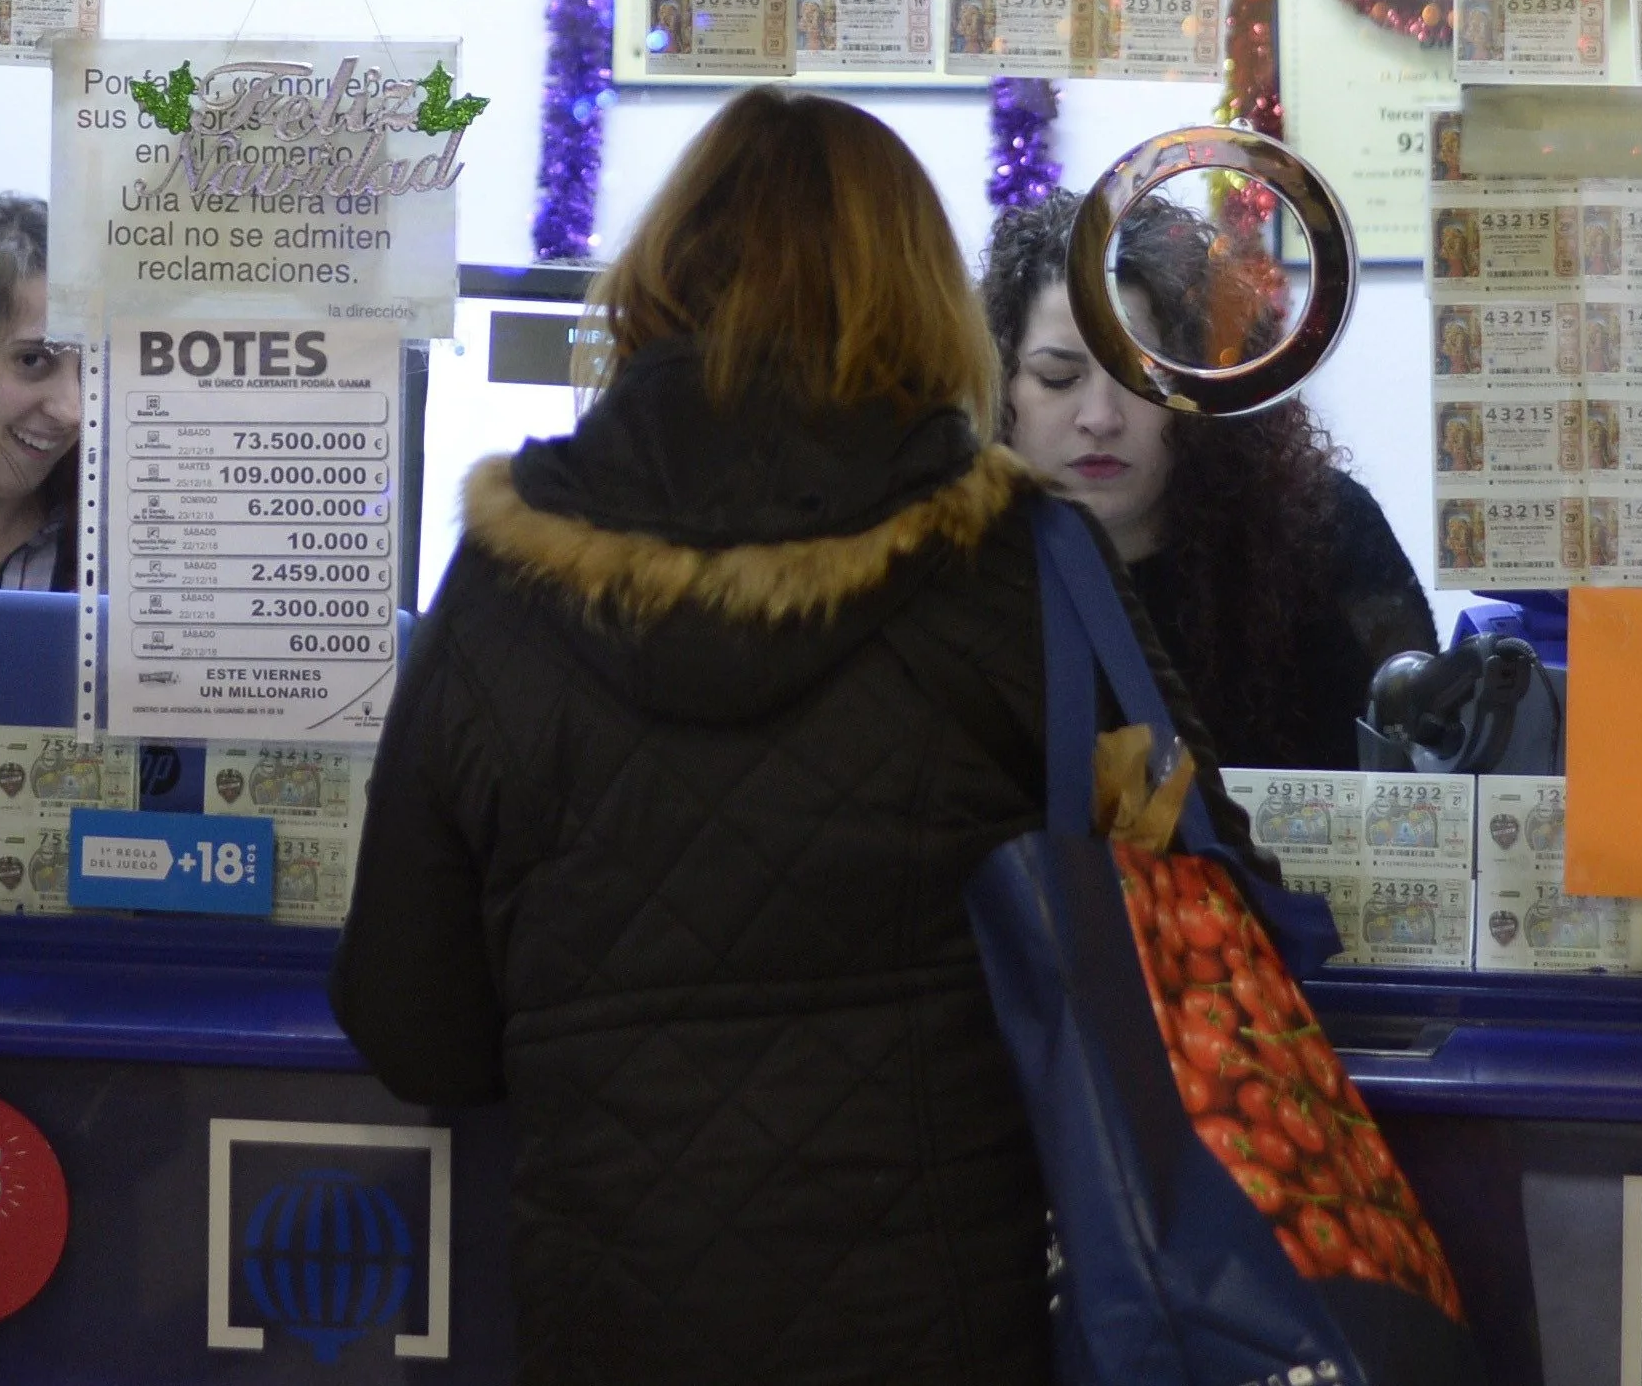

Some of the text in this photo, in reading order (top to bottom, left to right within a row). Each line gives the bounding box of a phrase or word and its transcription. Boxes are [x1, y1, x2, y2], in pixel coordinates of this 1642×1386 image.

[85, 69, 134, 95] Por
[77, 108, 127, 129] sus
[134, 126, 465, 198] Navidad
[136, 144, 169, 163] en
[122, 187, 179, 213] Una
[190, 193, 240, 213] vez
[1482, 213, 1550, 229] 43215
[107, 219, 392, 251] local no se admiten
[138, 255, 359, 284] reclamaciones.
[329, 304, 342, 319] la
[140, 331, 327, 377] BOTES
[198, 378, 371, 388] UN ÚNICO ACERTANTE PODRÍA GANAR
[234, 432, 366, 450] 73.500.000
[219, 466, 367, 485] 109.000.000
[247, 498, 367, 517] 6.200.000
[287, 532, 368, 550] 10.000
[251, 564, 370, 583] 2.459.000
[251, 599, 370, 617] 2.300.000
[289, 634, 370, 653] 60.000
[206, 668, 322, 681] ESTE VIERNES
[200, 686, 328, 699] UN MILLONARIO
[1267, 781, 1335, 798] 69313
[1375, 785, 1442, 801] 24292
[117, 846, 157, 858] REGLA
[90, 858, 158, 871] DEL JUEGO
[178, 842, 244, 884] +18
